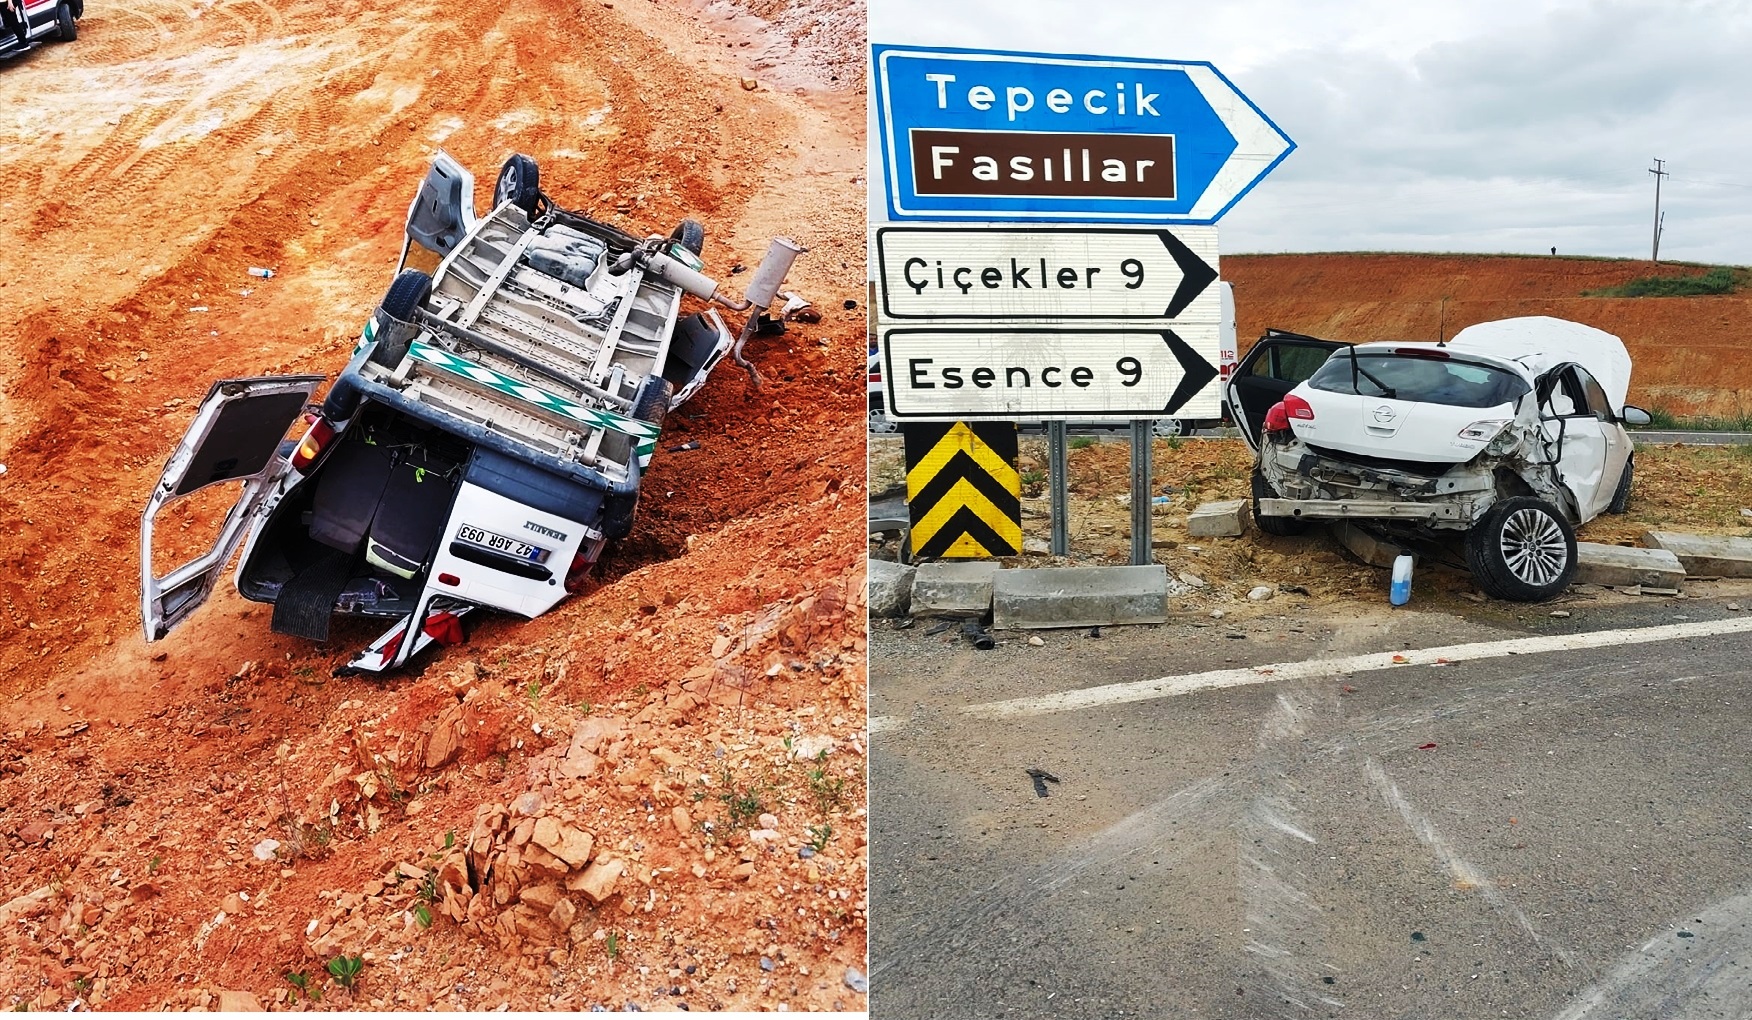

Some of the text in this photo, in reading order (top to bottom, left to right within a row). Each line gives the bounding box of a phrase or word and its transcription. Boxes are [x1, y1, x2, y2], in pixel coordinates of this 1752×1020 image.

[925, 73, 1161, 121] Tepecik
[931, 145, 1156, 182] Fasıllar
[903, 257, 1144, 295] Çiçekler 9
[908, 356, 1142, 389] Esence 9
[460, 526, 533, 556] 42 AGR 093
[523, 520, 568, 542] RENAULT
